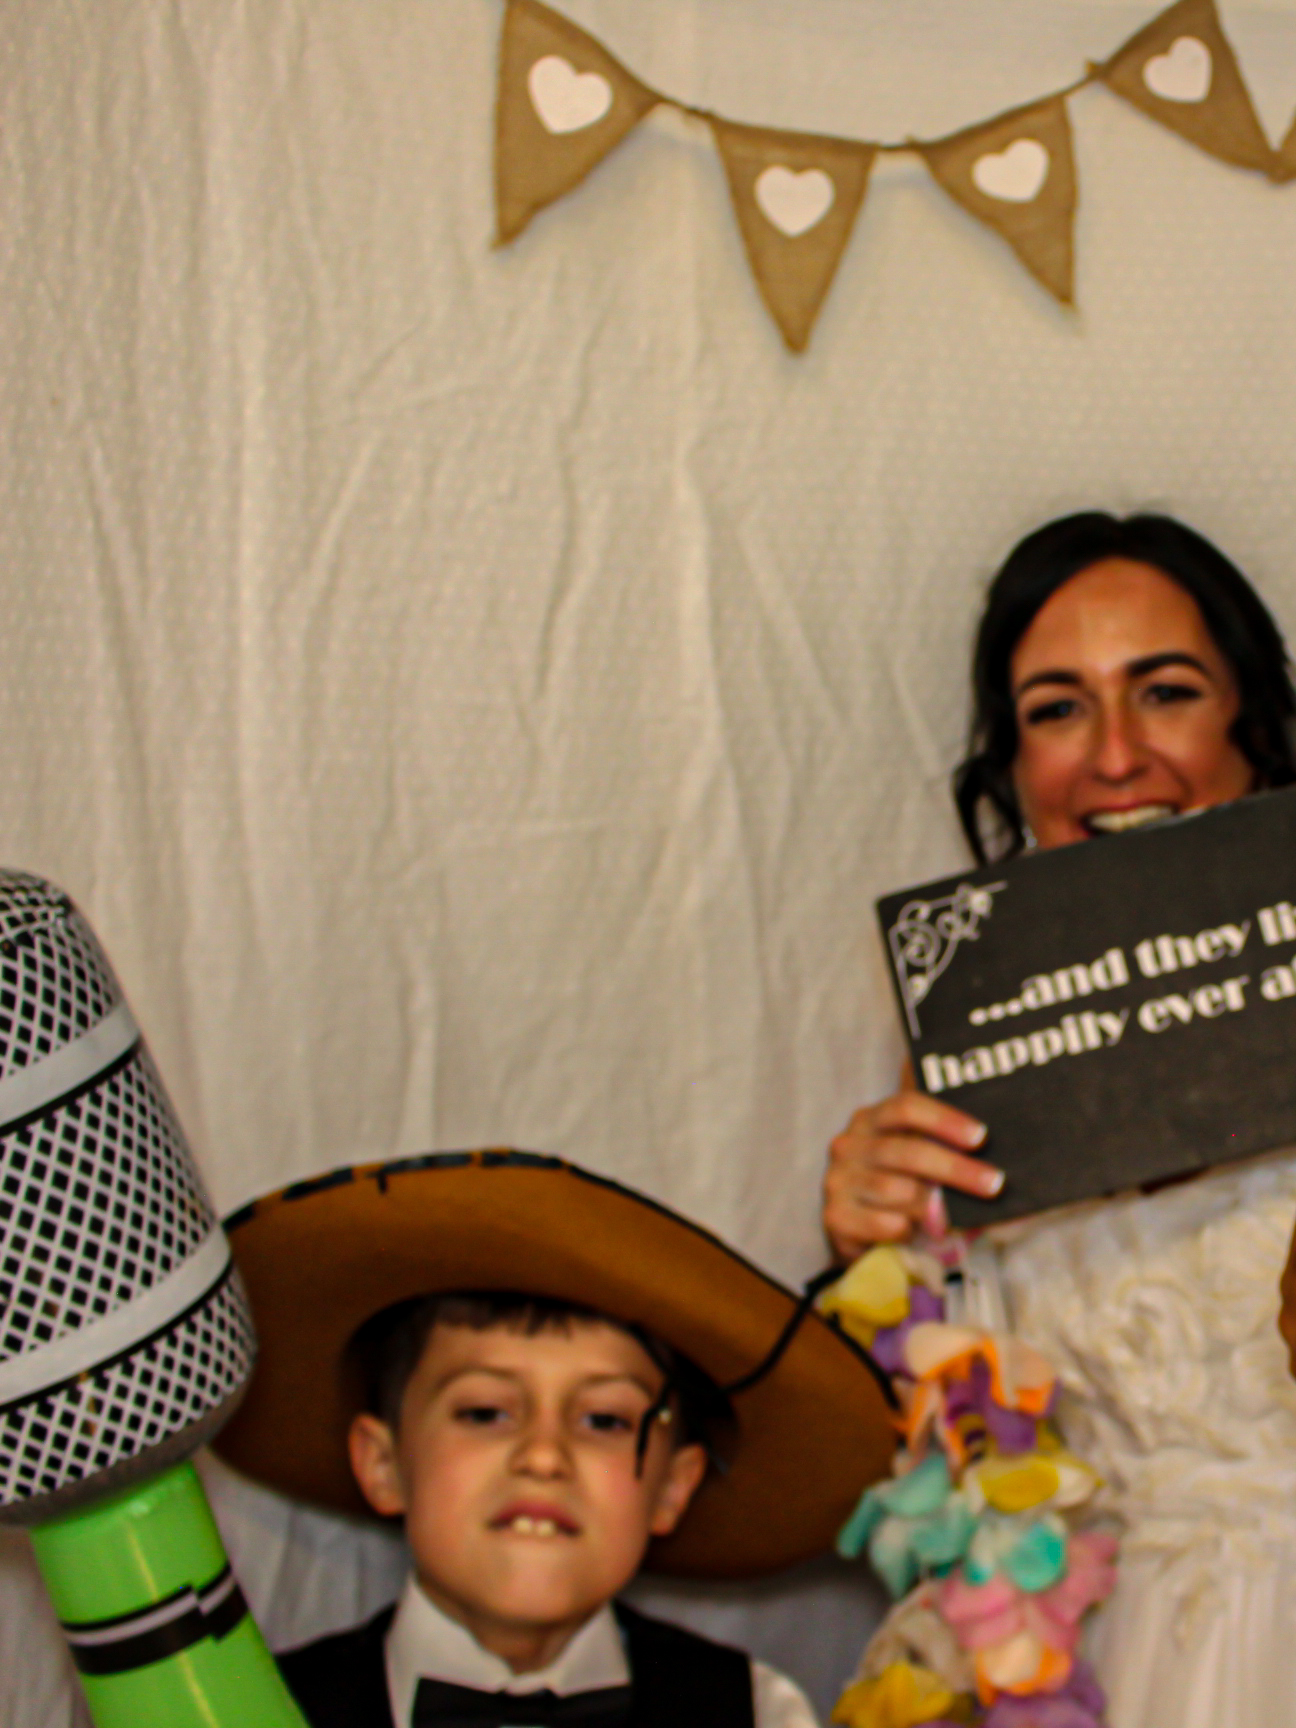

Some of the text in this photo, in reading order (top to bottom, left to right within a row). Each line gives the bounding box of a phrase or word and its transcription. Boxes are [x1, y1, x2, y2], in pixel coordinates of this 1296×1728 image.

[1134, 918, 1251, 979] they
[921, 1008, 1130, 1093] happily
[1139, 975, 1250, 1032] ever
